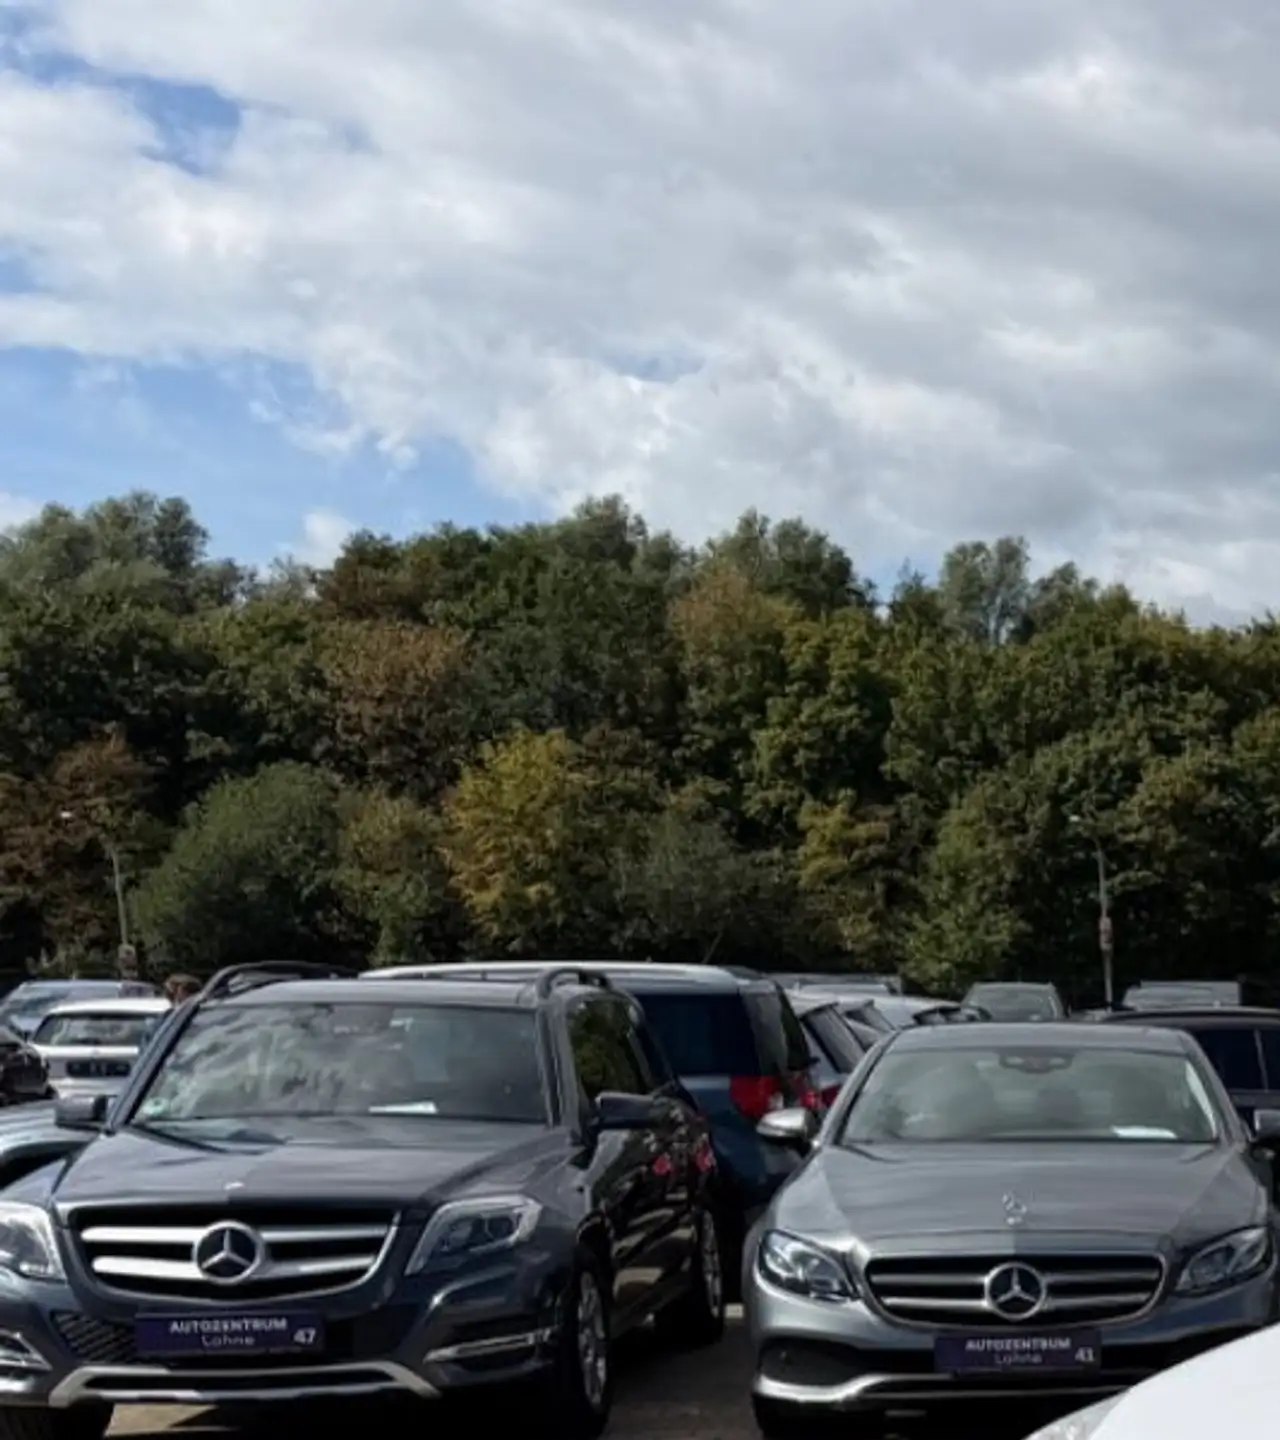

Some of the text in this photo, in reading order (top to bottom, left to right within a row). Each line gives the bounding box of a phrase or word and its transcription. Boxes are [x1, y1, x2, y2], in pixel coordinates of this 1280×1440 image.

[169, 1317, 288, 1335] AUTOZENTRUM
[293, 1327, 317, 1345] 47
[965, 1337, 1071, 1351] AUTOZENTRUM
